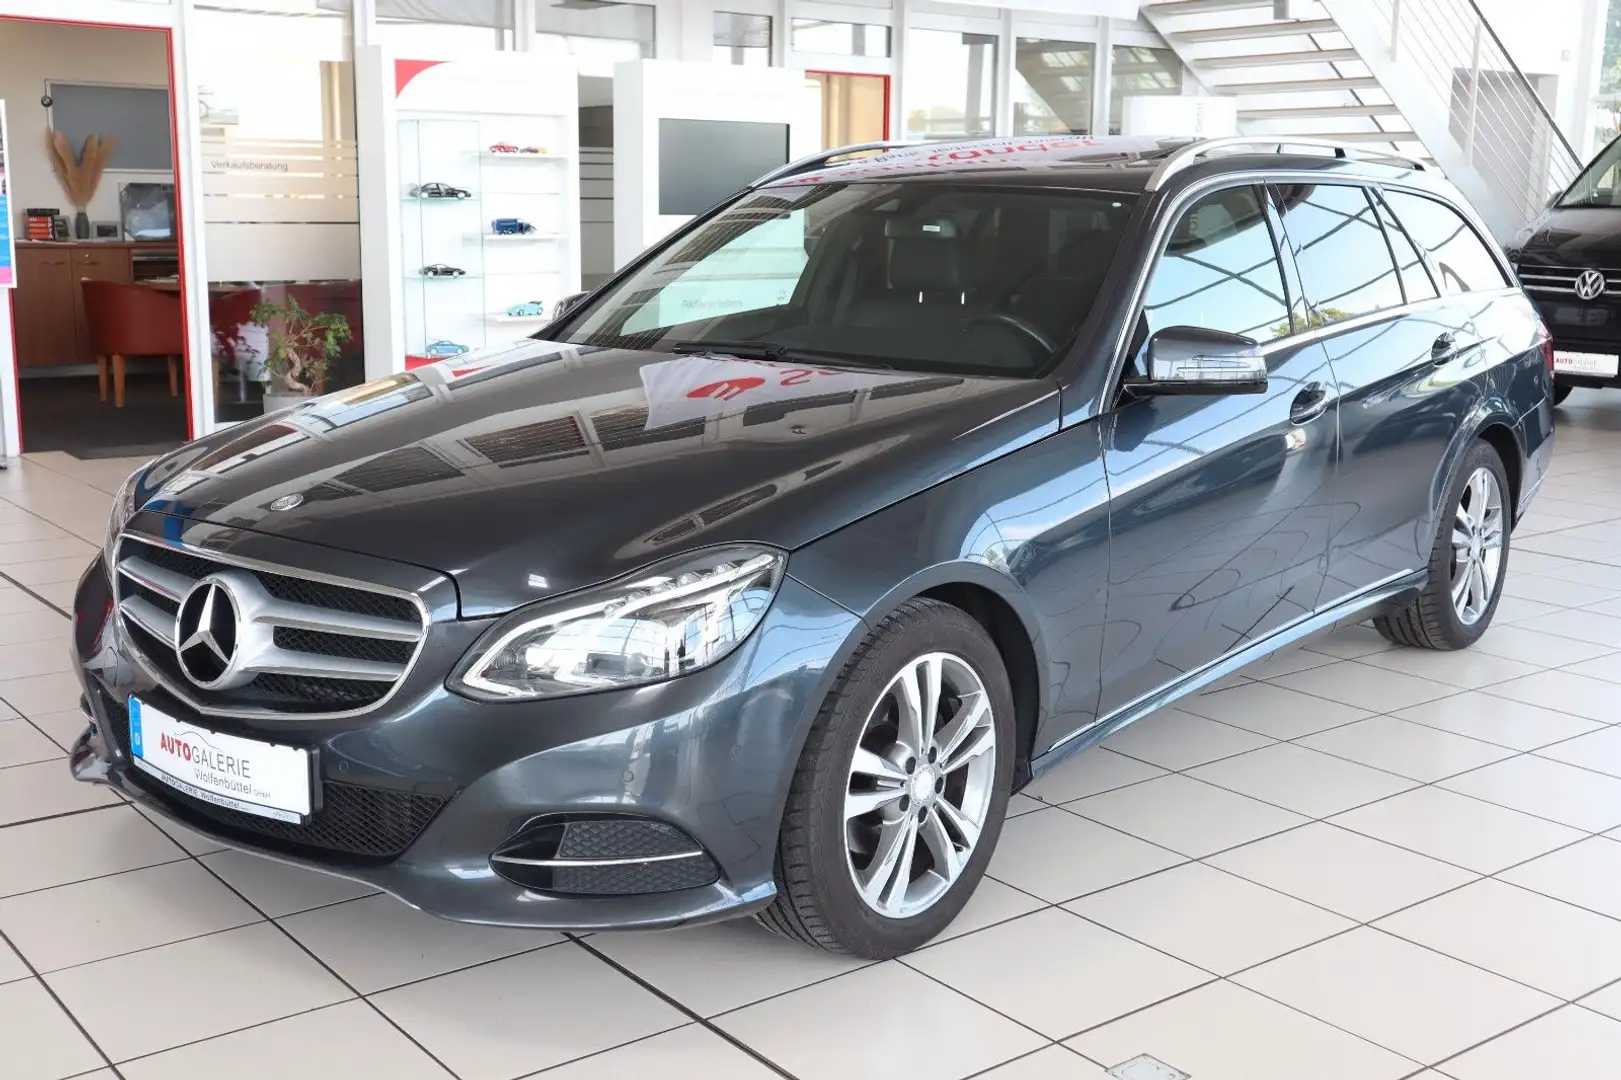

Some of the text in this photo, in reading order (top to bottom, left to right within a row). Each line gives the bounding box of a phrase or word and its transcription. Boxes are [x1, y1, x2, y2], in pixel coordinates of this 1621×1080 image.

[210, 160, 288, 172] Verkaufsberatung
[160, 732, 251, 779] AUTOGALERIE
[194, 767, 252, 796] Wolfenbüttel
